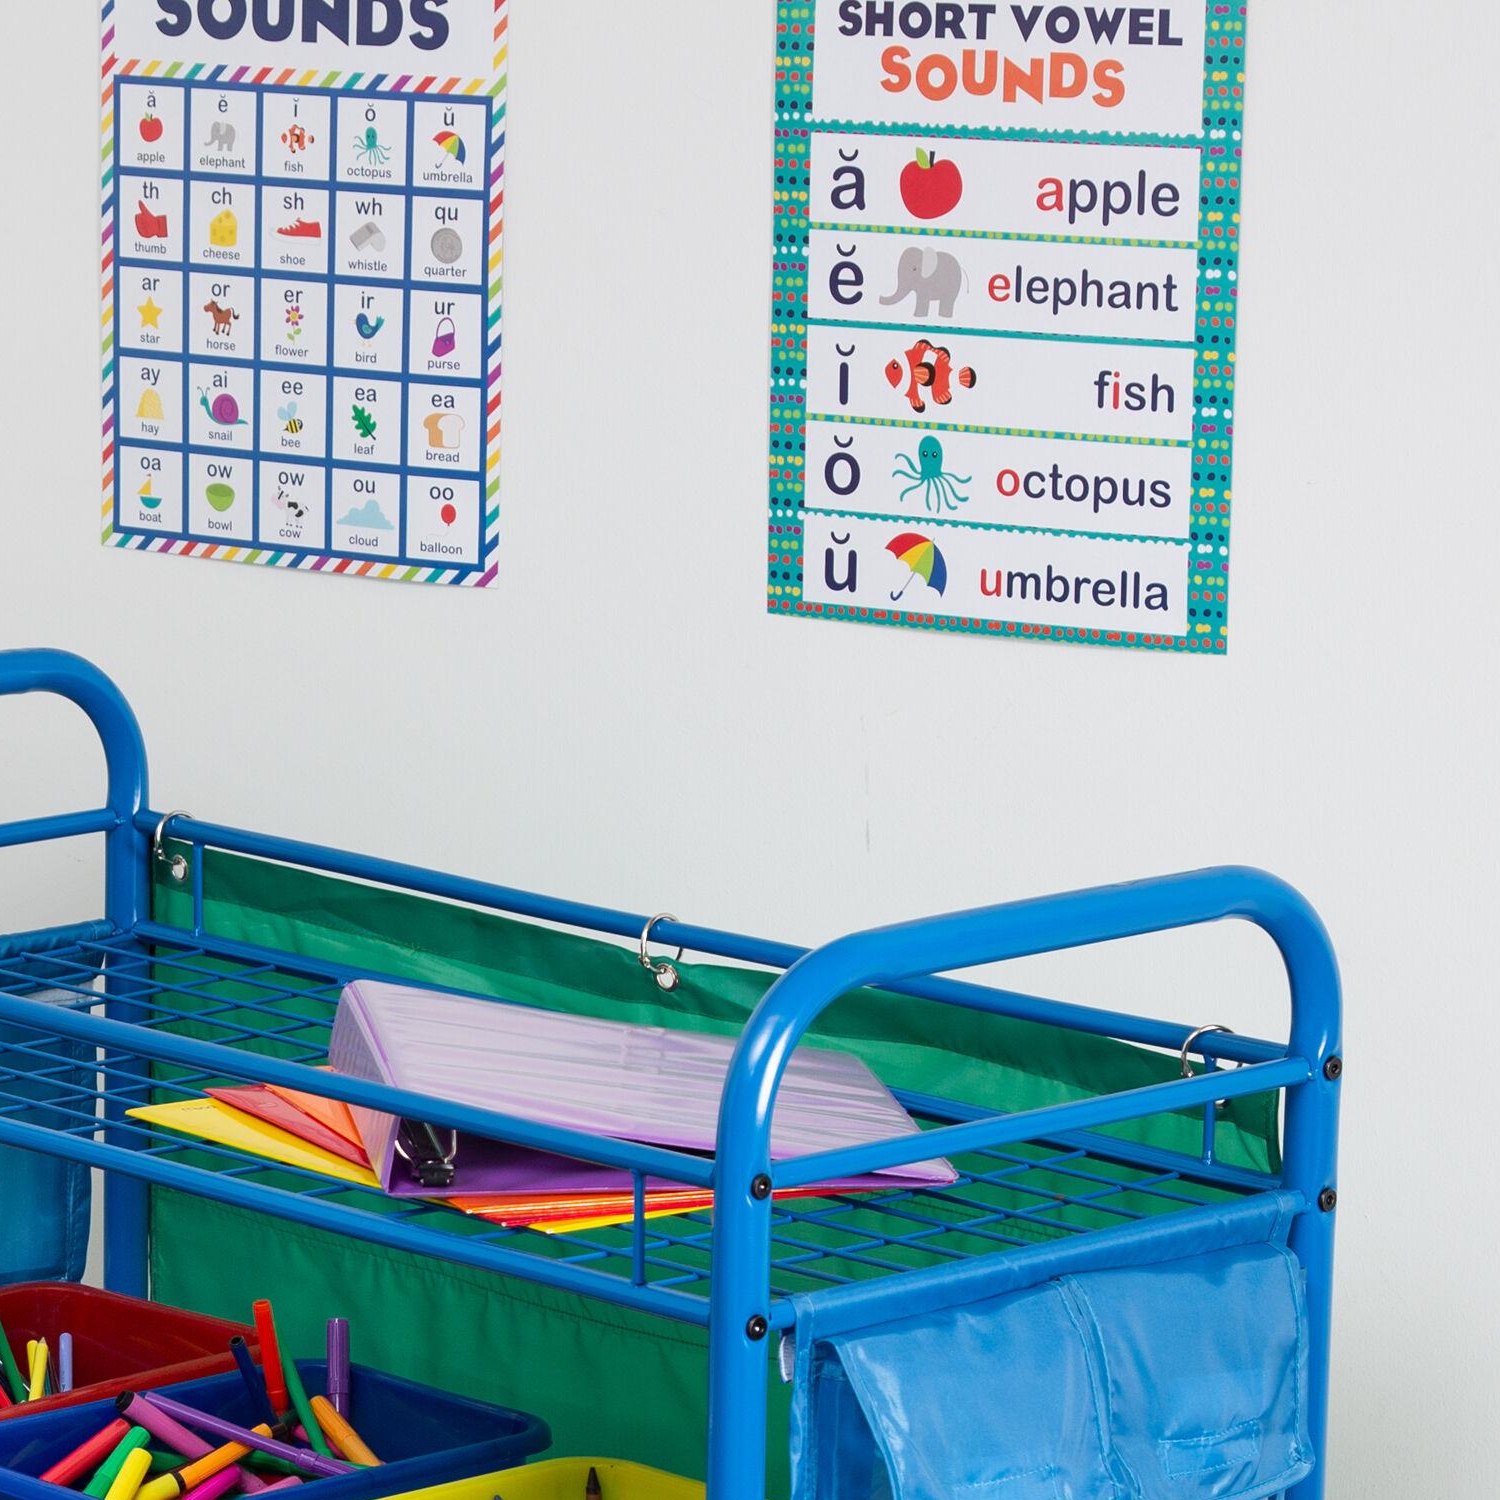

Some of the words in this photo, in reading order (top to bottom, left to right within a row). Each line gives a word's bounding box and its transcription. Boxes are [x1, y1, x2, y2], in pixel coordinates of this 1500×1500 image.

[156, 0, 449, 50] SOUNDS
[838, 0, 996, 40] SHORT
[1010, 5, 1183, 46] VOWEL
[881, 45, 1125, 107] SOUNDS
[137, 152, 165, 164] apple
[200, 155, 245, 168] elephant
[284, 161, 303, 172] fish
[347, 166, 391, 179] octopus
[423, 171, 472, 183] umbrella
[143, 181, 159, 199] th
[212, 187, 232, 205] ch
[284, 192, 304, 210] sh
[1036, 169, 1179, 226] apple
[355, 198, 382, 216] wh
[435, 207, 458, 225] qu
[135, 242, 166, 254] thumb
[203, 248, 240, 260] cheese
[280, 254, 305, 265] shoe
[348, 259, 387, 271] whistle
[424, 266, 467, 277] quarter
[142, 278, 160, 291] ar
[212, 284, 230, 297] or
[988, 265, 1178, 315] elephant
[284, 290, 303, 303] er
[362, 291, 374, 309] ir
[435, 302, 455, 315] ur
[140, 333, 160, 343] star
[207, 338, 236, 351] horse
[275, 344, 308, 357] flower
[355, 352, 377, 363] bird
[428, 360, 460, 370] purse
[141, 368, 160, 386] ay
[213, 371, 227, 388] ai
[282, 381, 303, 395] ee
[1094, 370, 1174, 413] fish
[355, 388, 376, 402] ea
[432, 394, 454, 408] ea
[142, 422, 159, 436] hay
[209, 430, 232, 441] snail
[281, 436, 300, 448] bee
[354, 443, 375, 455] leaf
[426, 450, 459, 462] bread
[141, 457, 161, 471] oa
[207, 464, 232, 479] ow
[279, 472, 304, 486] ow
[353, 479, 375, 493] ou
[997, 464, 1171, 513] octopus
[430, 486, 454, 500] oo
[140, 511, 161, 523] boat
[208, 518, 232, 531] bowl
[279, 525, 302, 538] cow
[349, 534, 378, 547] cloud
[420, 541, 462, 555] balloon
[981, 565, 1168, 611] umbrella
